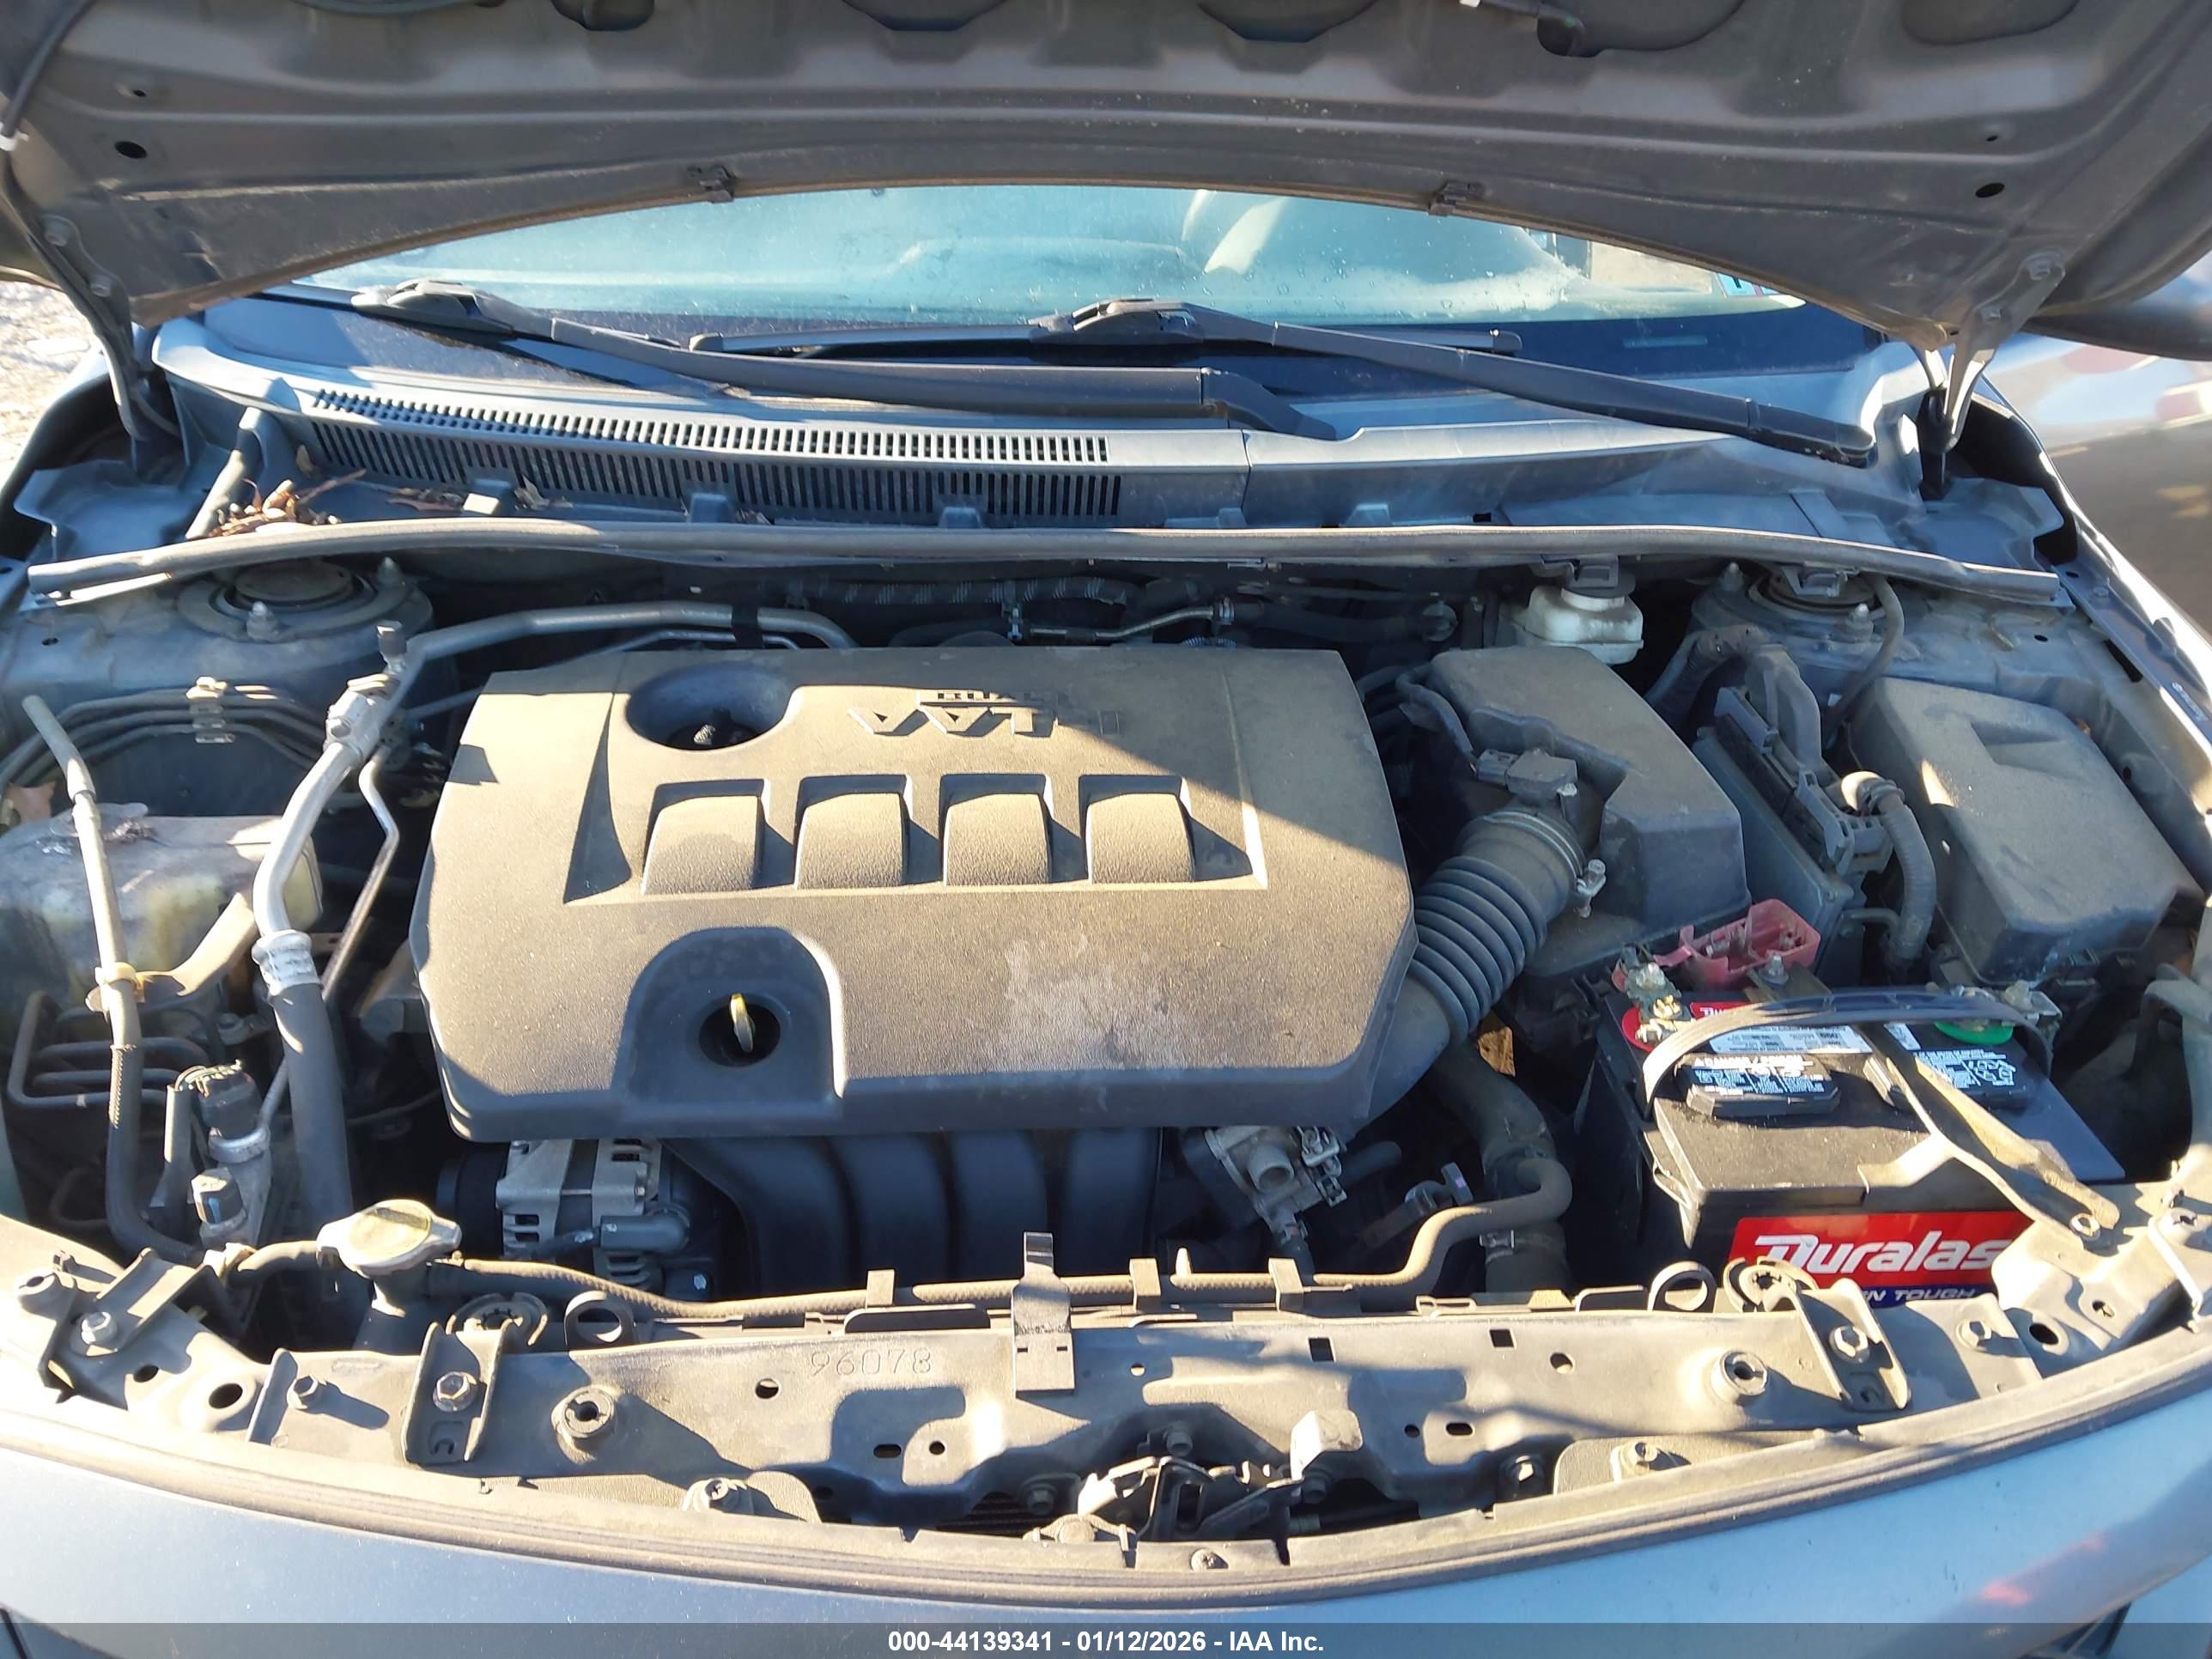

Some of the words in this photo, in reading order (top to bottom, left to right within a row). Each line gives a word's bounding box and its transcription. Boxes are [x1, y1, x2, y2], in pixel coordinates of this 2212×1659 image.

[1754, 1230, 2014, 1274] Duralas
[1894, 1288, 1975, 1302] TOUGH
[810, 1348, 934, 1376] 96078
